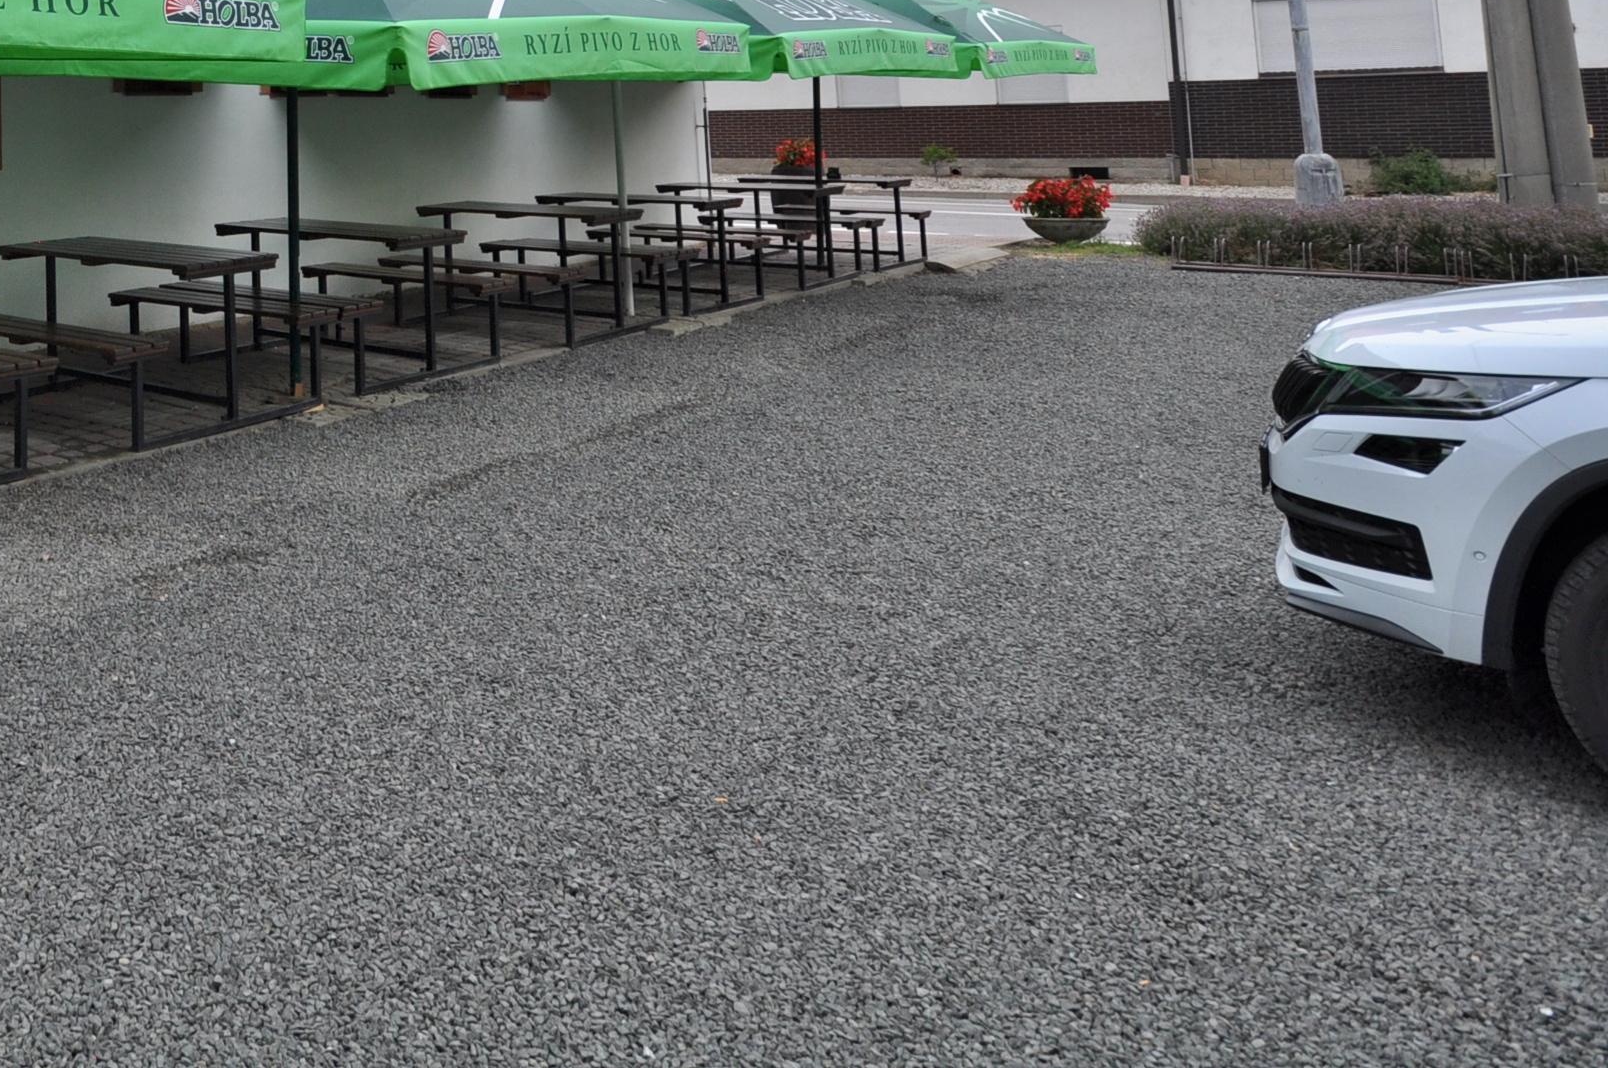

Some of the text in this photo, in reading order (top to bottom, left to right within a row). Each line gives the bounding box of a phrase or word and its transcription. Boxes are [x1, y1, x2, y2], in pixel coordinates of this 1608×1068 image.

[305, 35, 354, 64] LBA
[447, 33, 502, 60] HOLBA
[523, 27, 683, 56] RYZÍ PIVO Z HOR
[838, 35, 863, 56] RYZÍ
[866, 38, 889, 55] PIVO
[900, 40, 918, 55] HOR
